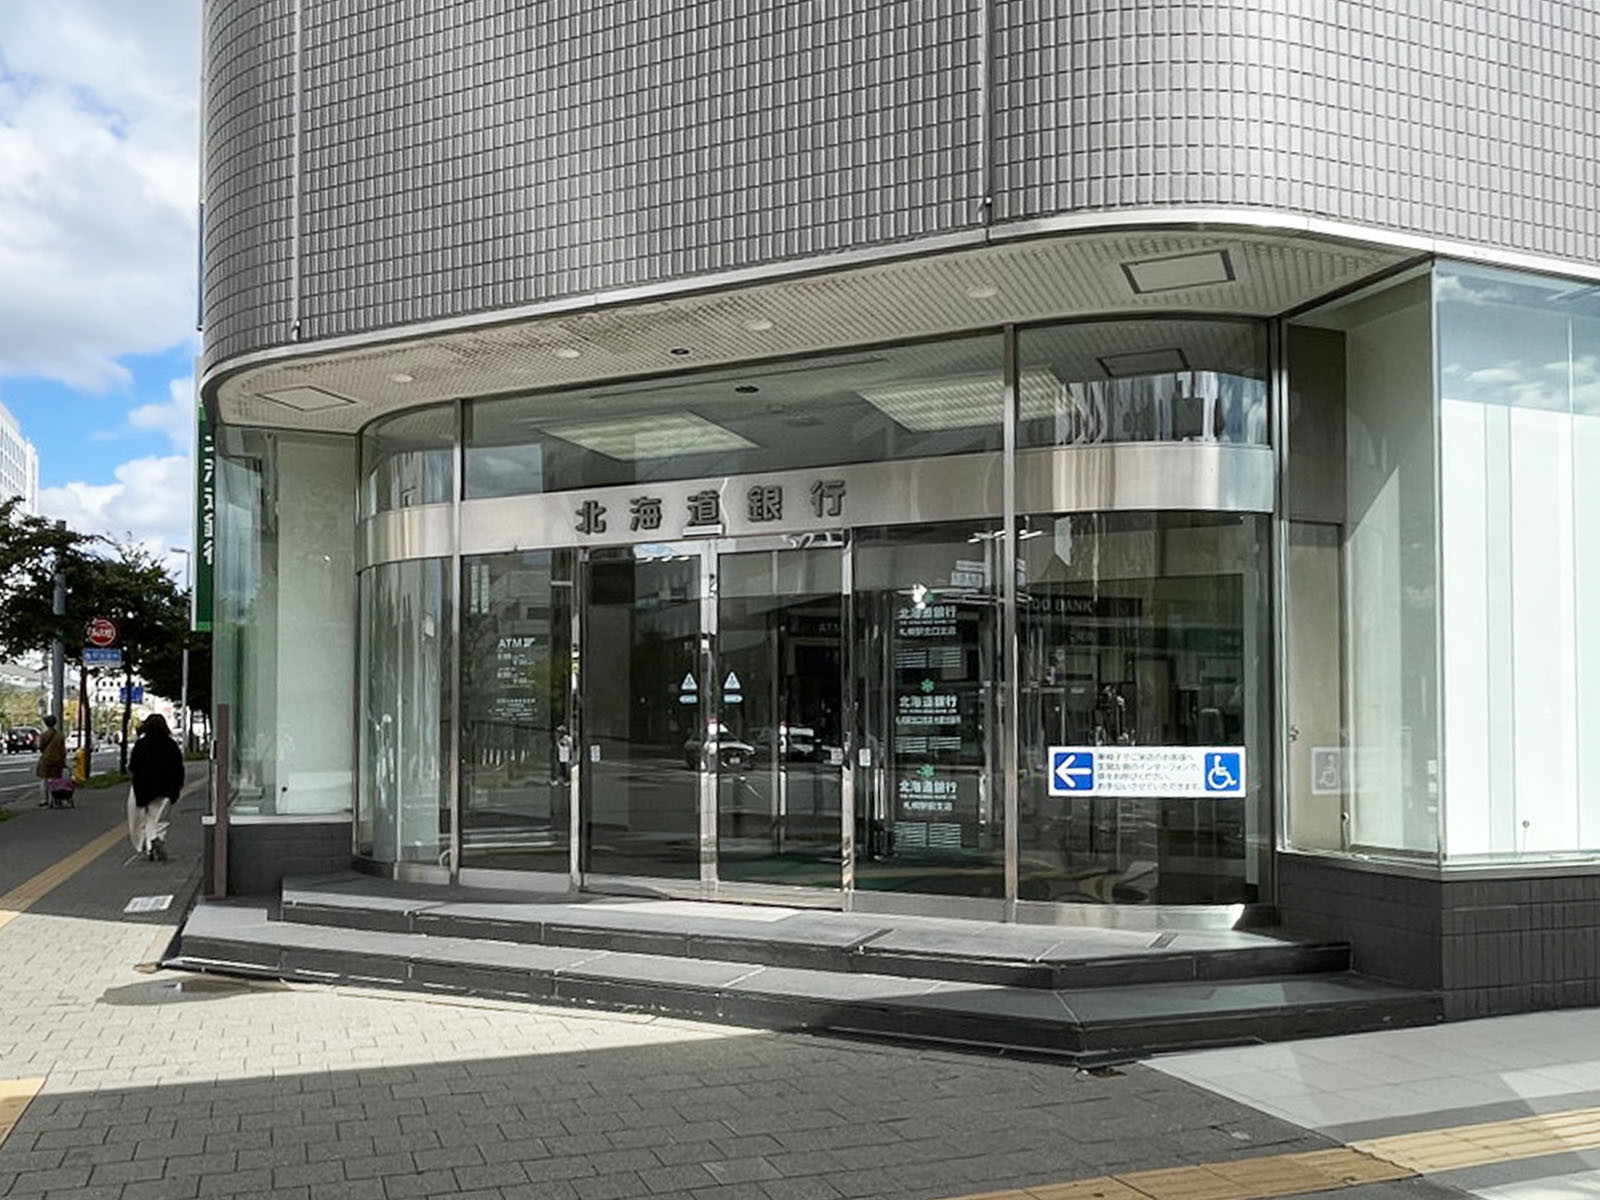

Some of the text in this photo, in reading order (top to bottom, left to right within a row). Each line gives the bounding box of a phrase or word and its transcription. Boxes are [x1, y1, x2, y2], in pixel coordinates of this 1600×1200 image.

[575, 480, 847, 535] 北海道銀行
[498, 638, 522, 648] ATM
[898, 695, 957, 708] 北海道銀行
[898, 780, 957, 793] 北海道銀行
